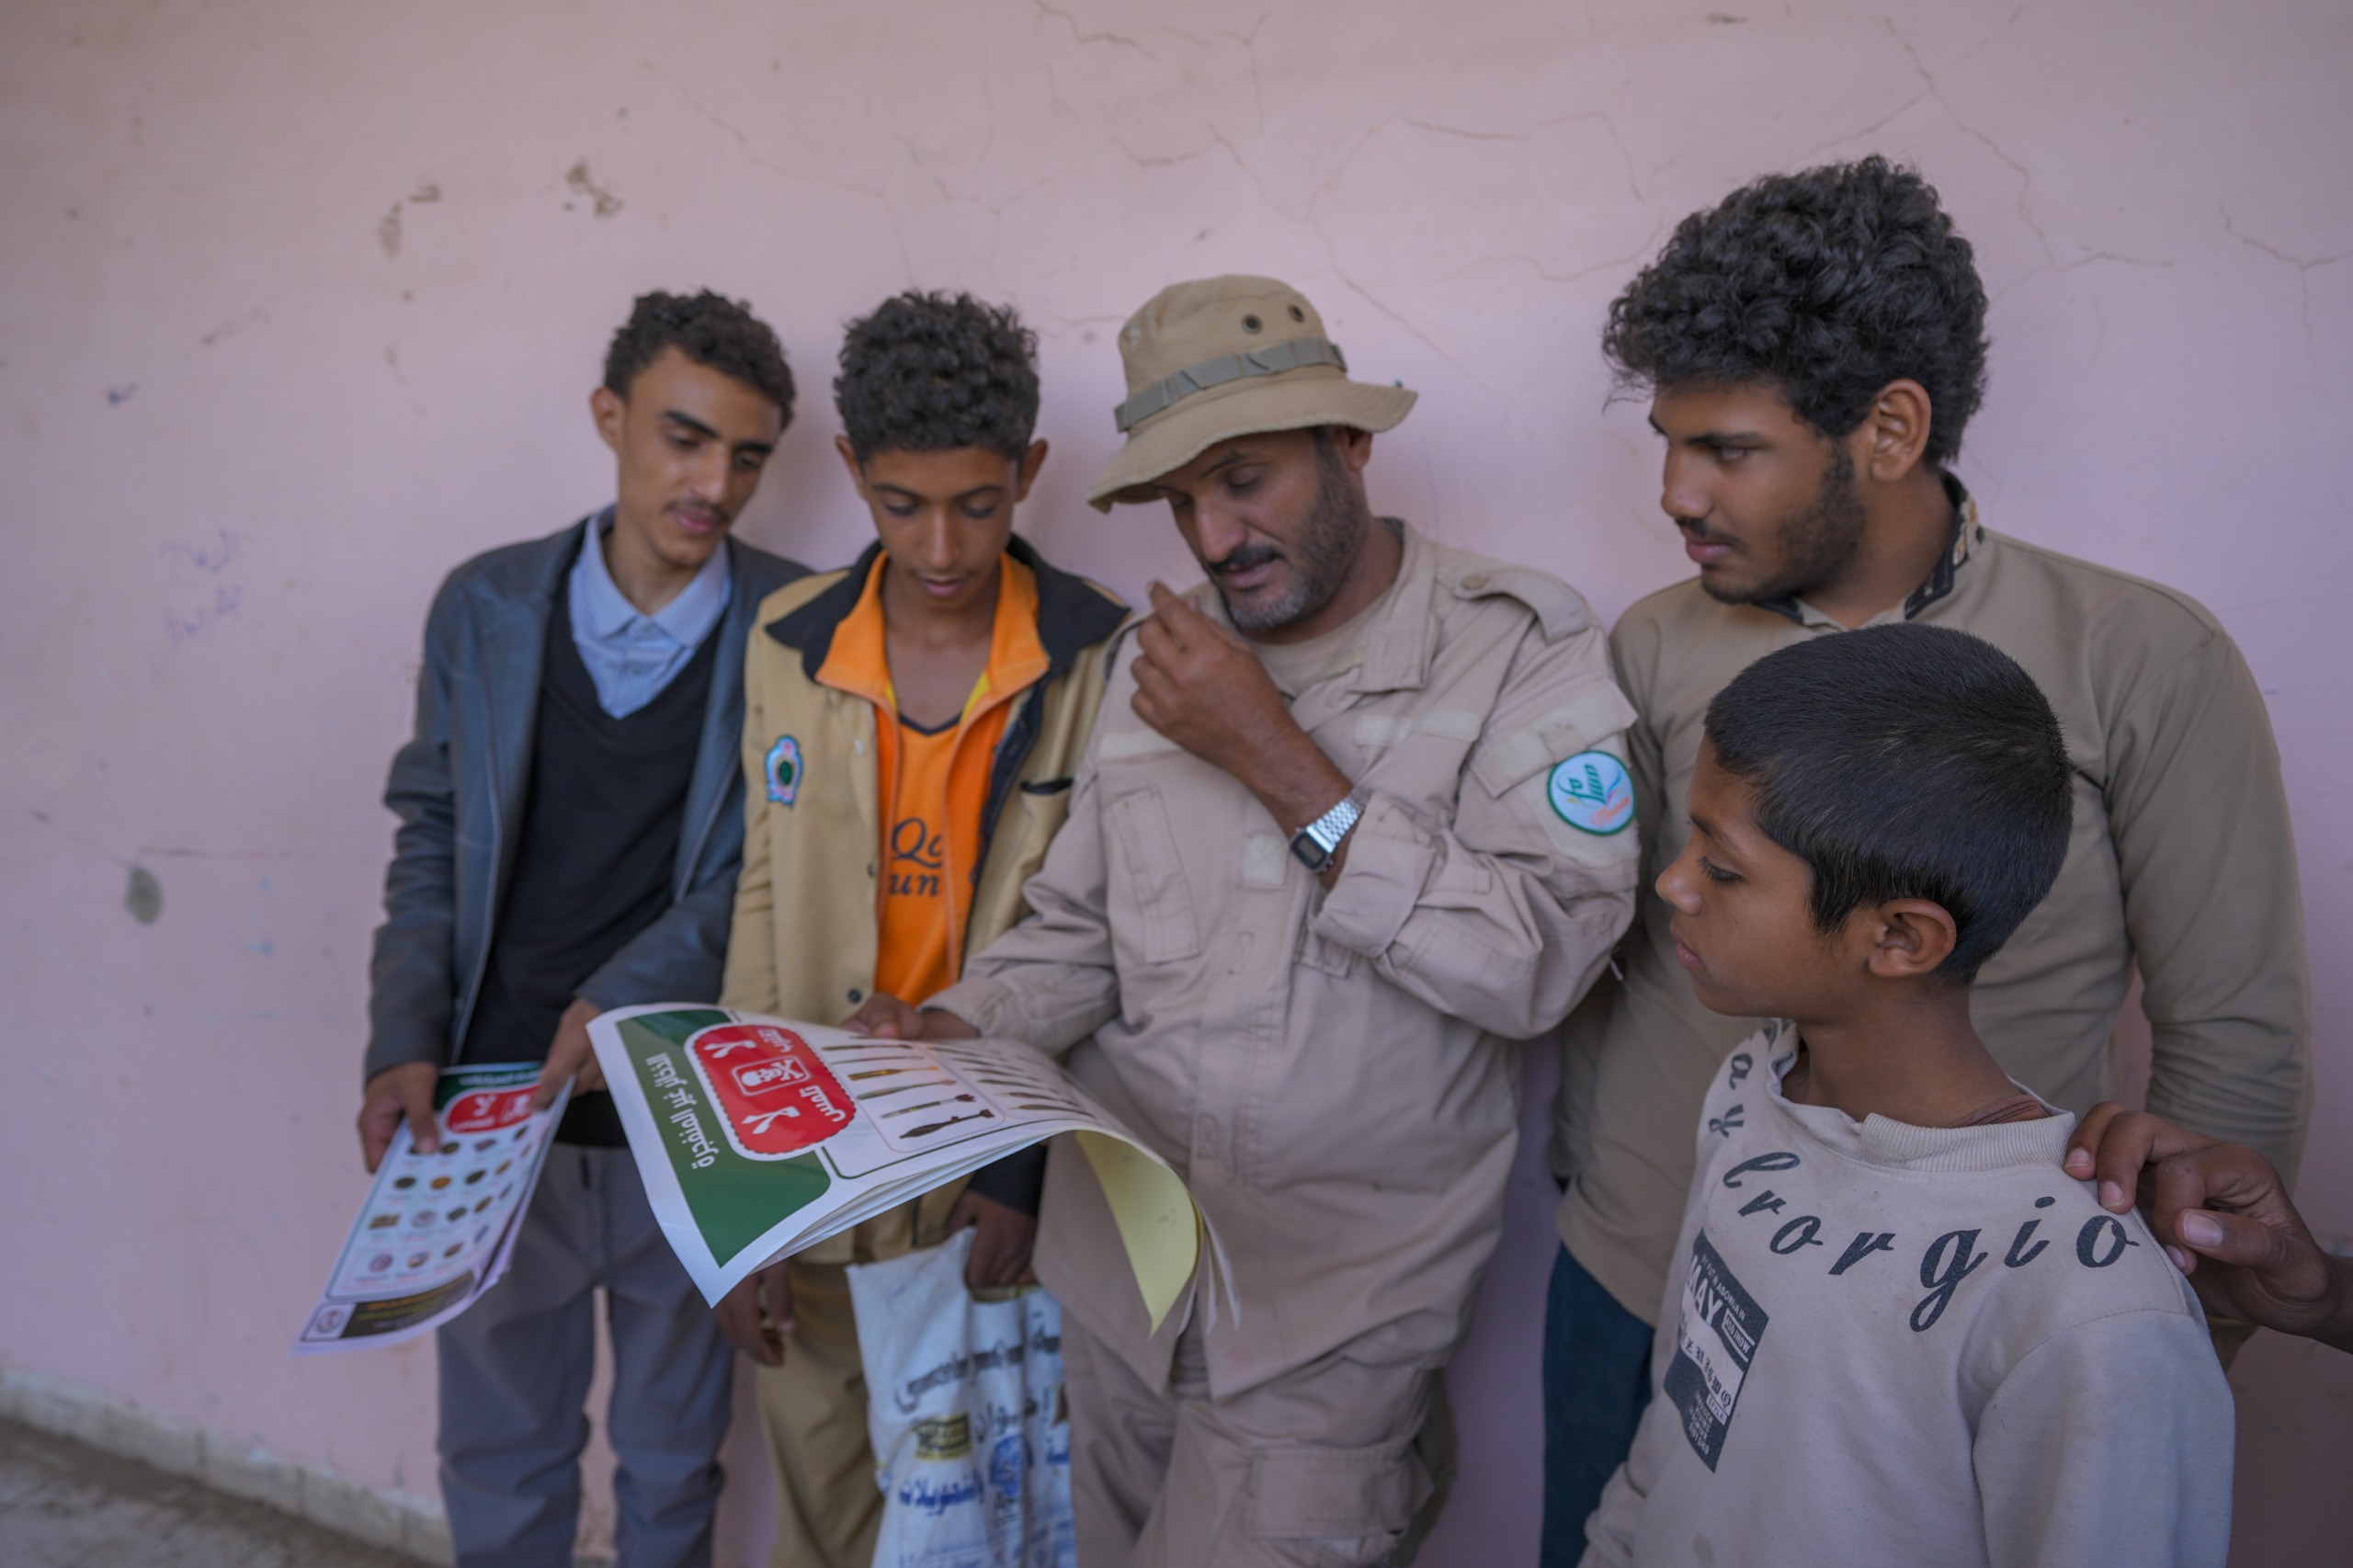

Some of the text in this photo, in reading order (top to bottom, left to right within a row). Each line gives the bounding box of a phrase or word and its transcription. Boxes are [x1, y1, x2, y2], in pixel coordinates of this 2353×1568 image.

[703, 1040, 757, 1059] لا
[645, 1052, 720, 1169] الذخائر غير المنفجرة
[741, 1106, 801, 1134] لا
[799, 1085, 846, 1122] تلمس
[1688, 1254, 1723, 1326] MAY
